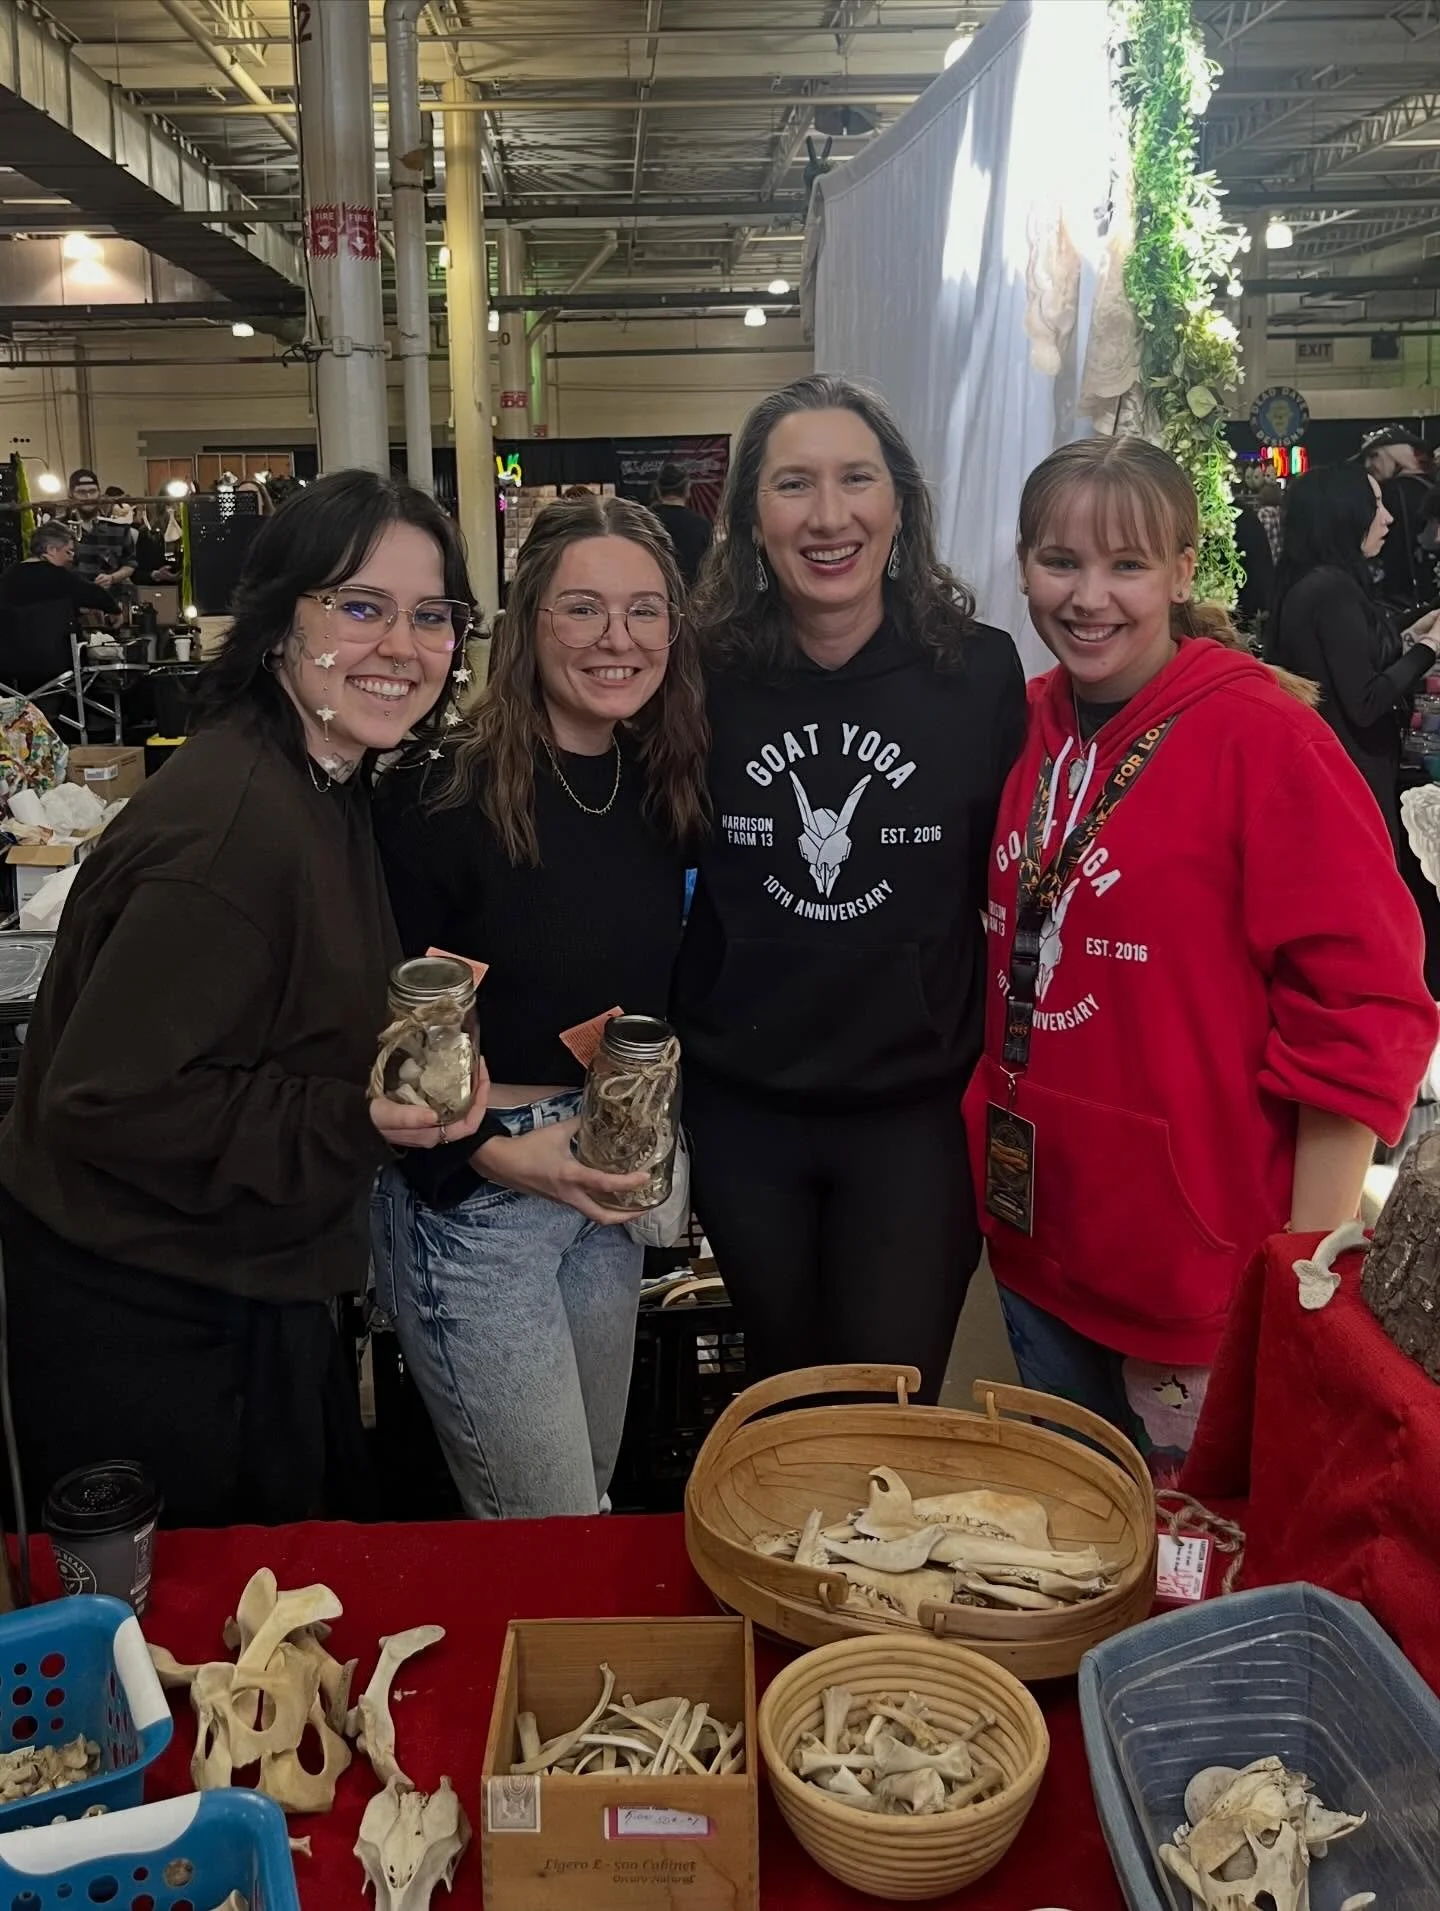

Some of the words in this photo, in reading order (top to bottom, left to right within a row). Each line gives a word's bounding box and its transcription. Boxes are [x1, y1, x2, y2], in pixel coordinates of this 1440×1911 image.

[1297, 342, 1332, 358] EXIT
[745, 723, 820, 788] GOAT
[841, 722, 918, 790] YOGA
[1113, 754, 1145, 787] FOR
[722, 814, 774, 833] HARRISON
[880, 828, 911, 845] EST.
[913, 825, 943, 844] 2016
[727, 830, 757, 847] FARM
[760, 833, 774, 848] 13
[1077, 838, 1122, 898] GA
[762, 874, 795, 909] 10TH
[793, 879, 894, 921] ANNIVERSARY
[1085, 936, 1113, 958] EST.
[1115, 941, 1148, 963] 2016
[997, 969, 1012, 998] 10T
[1032, 992, 1100, 1032] NIVERSARY
